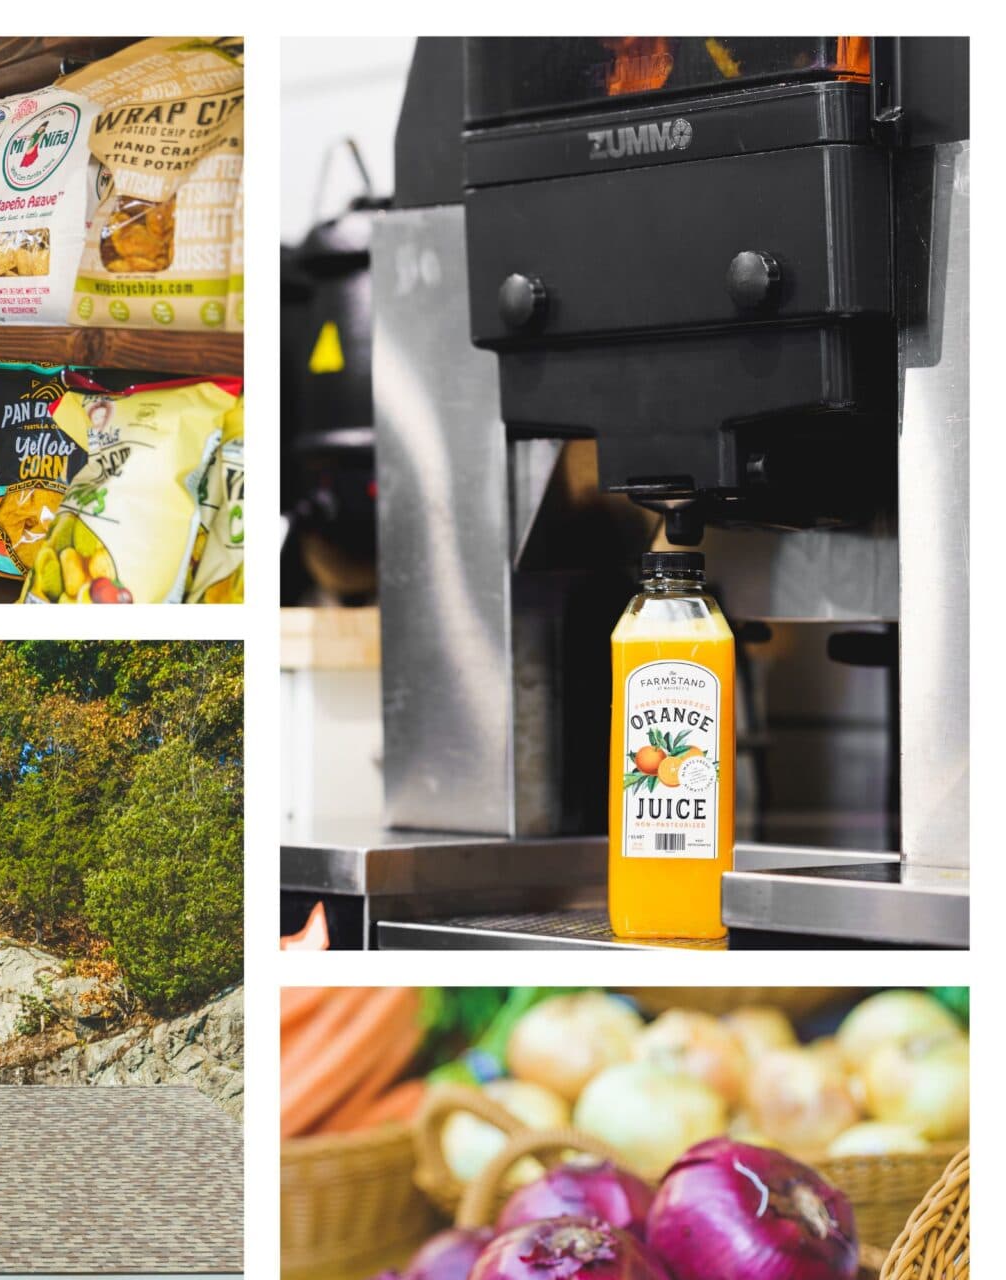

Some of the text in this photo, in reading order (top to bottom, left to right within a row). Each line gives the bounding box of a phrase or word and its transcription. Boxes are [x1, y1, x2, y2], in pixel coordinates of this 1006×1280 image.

[95, 102, 187, 134] WRAP
[10, 130, 69, 155] Mi Niña
[120, 125, 157, 136] POTATO
[161, 127, 186, 137] CHIP
[587, 118, 692, 160] ZUMMO
[114, 141, 155, 154] HAND
[28, 191, 65, 208] Agave"
[1, 401, 30, 429] PAN
[15, 432, 77, 461] Yellow
[20, 455, 68, 482] CORN
[641, 676, 706, 688] FARMSTAND
[630, 707, 714, 733] ORANGE
[636, 798, 706, 820] JUICE
